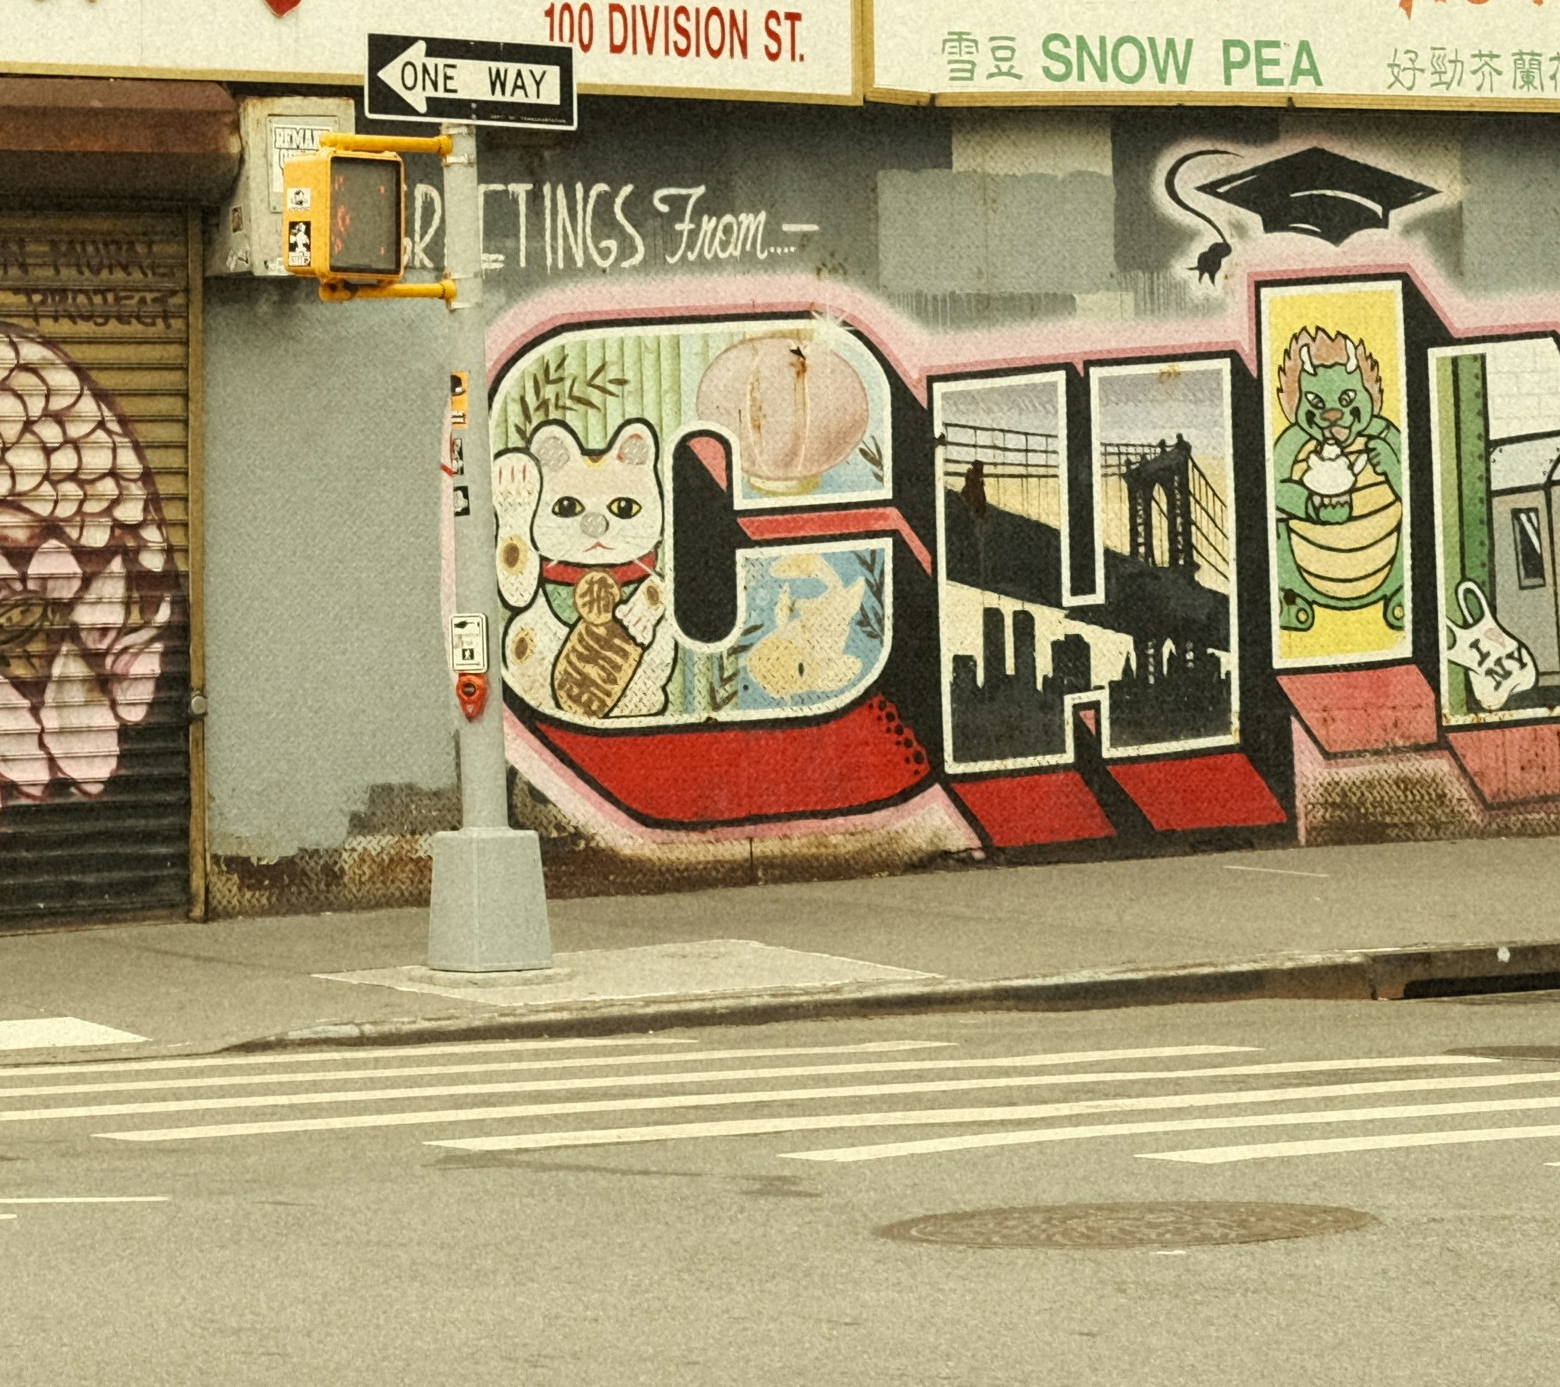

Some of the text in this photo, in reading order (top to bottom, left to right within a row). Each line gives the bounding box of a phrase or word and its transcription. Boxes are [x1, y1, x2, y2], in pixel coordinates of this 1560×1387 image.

[543, 0, 807, 64] 100 DIVISION ST.
[398, 60, 549, 101] ONE WAY
[1040, 33, 1324, 89] SNOW PEA
